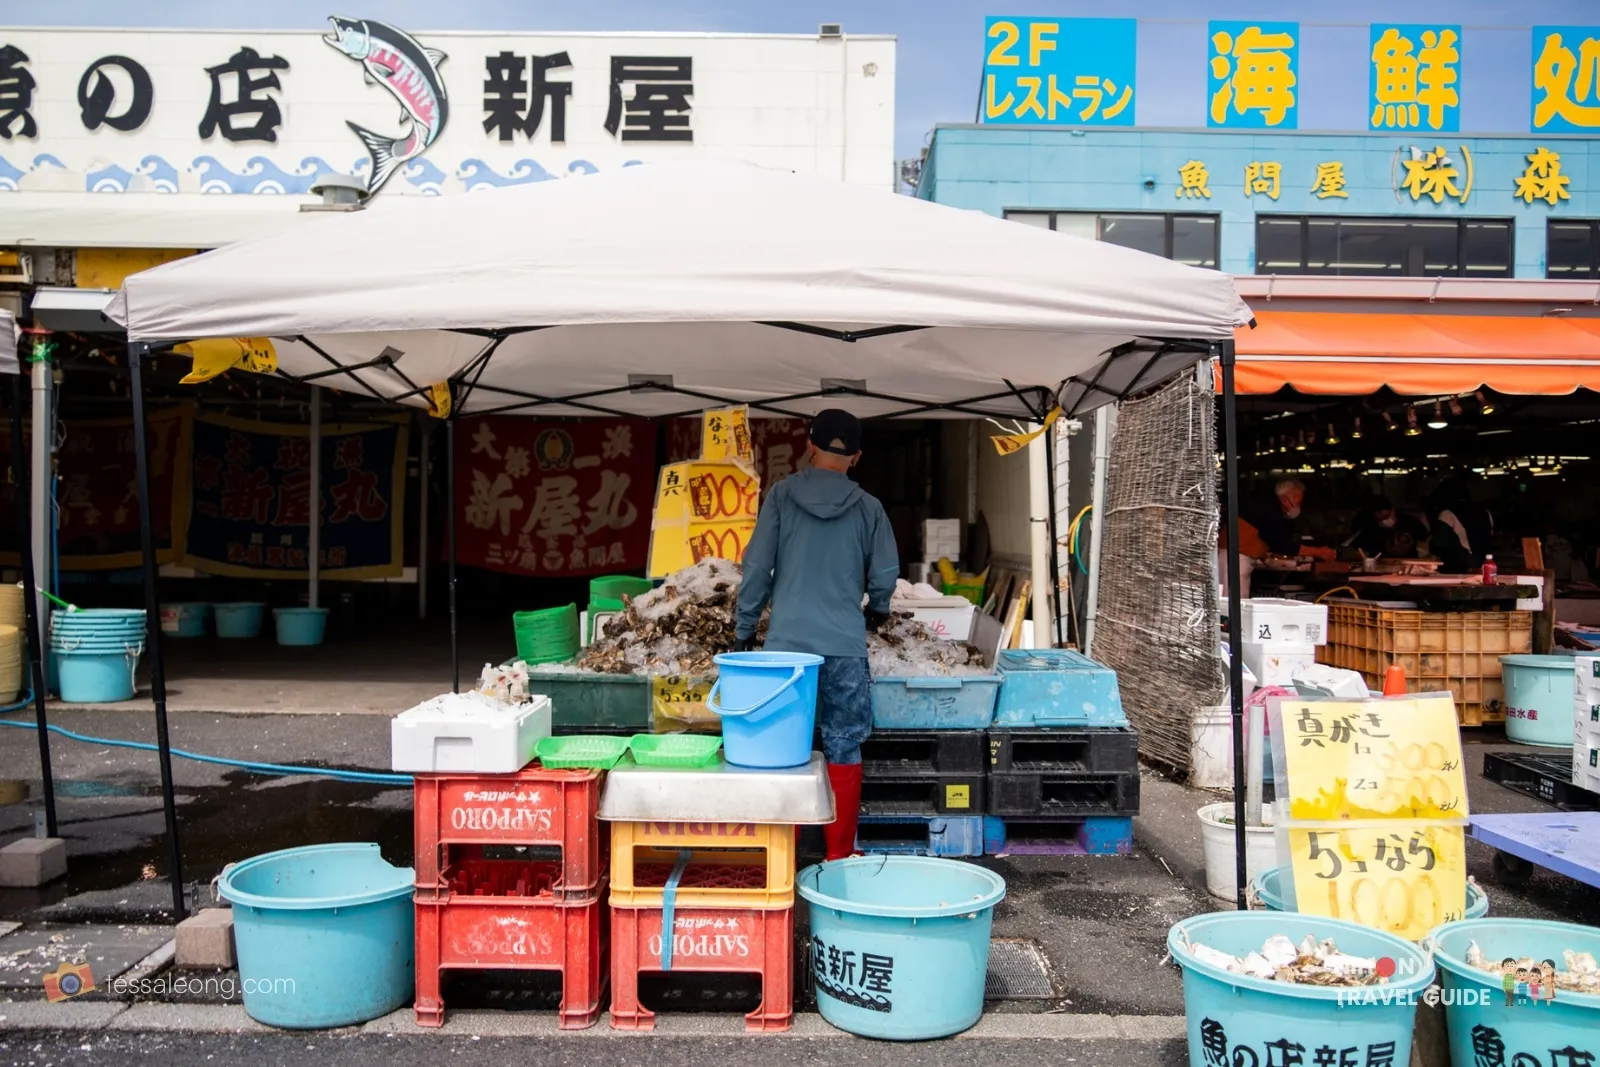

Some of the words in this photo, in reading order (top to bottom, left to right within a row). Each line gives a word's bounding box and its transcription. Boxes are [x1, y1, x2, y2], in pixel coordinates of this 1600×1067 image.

[987, 23, 1060, 66] 2F
[986, 75, 1134, 121] レストラン
[464, 467, 639, 536] 新屋丸
[1294, 708, 1390, 748] 真がき
[451, 807, 552, 832] SAPPORO
